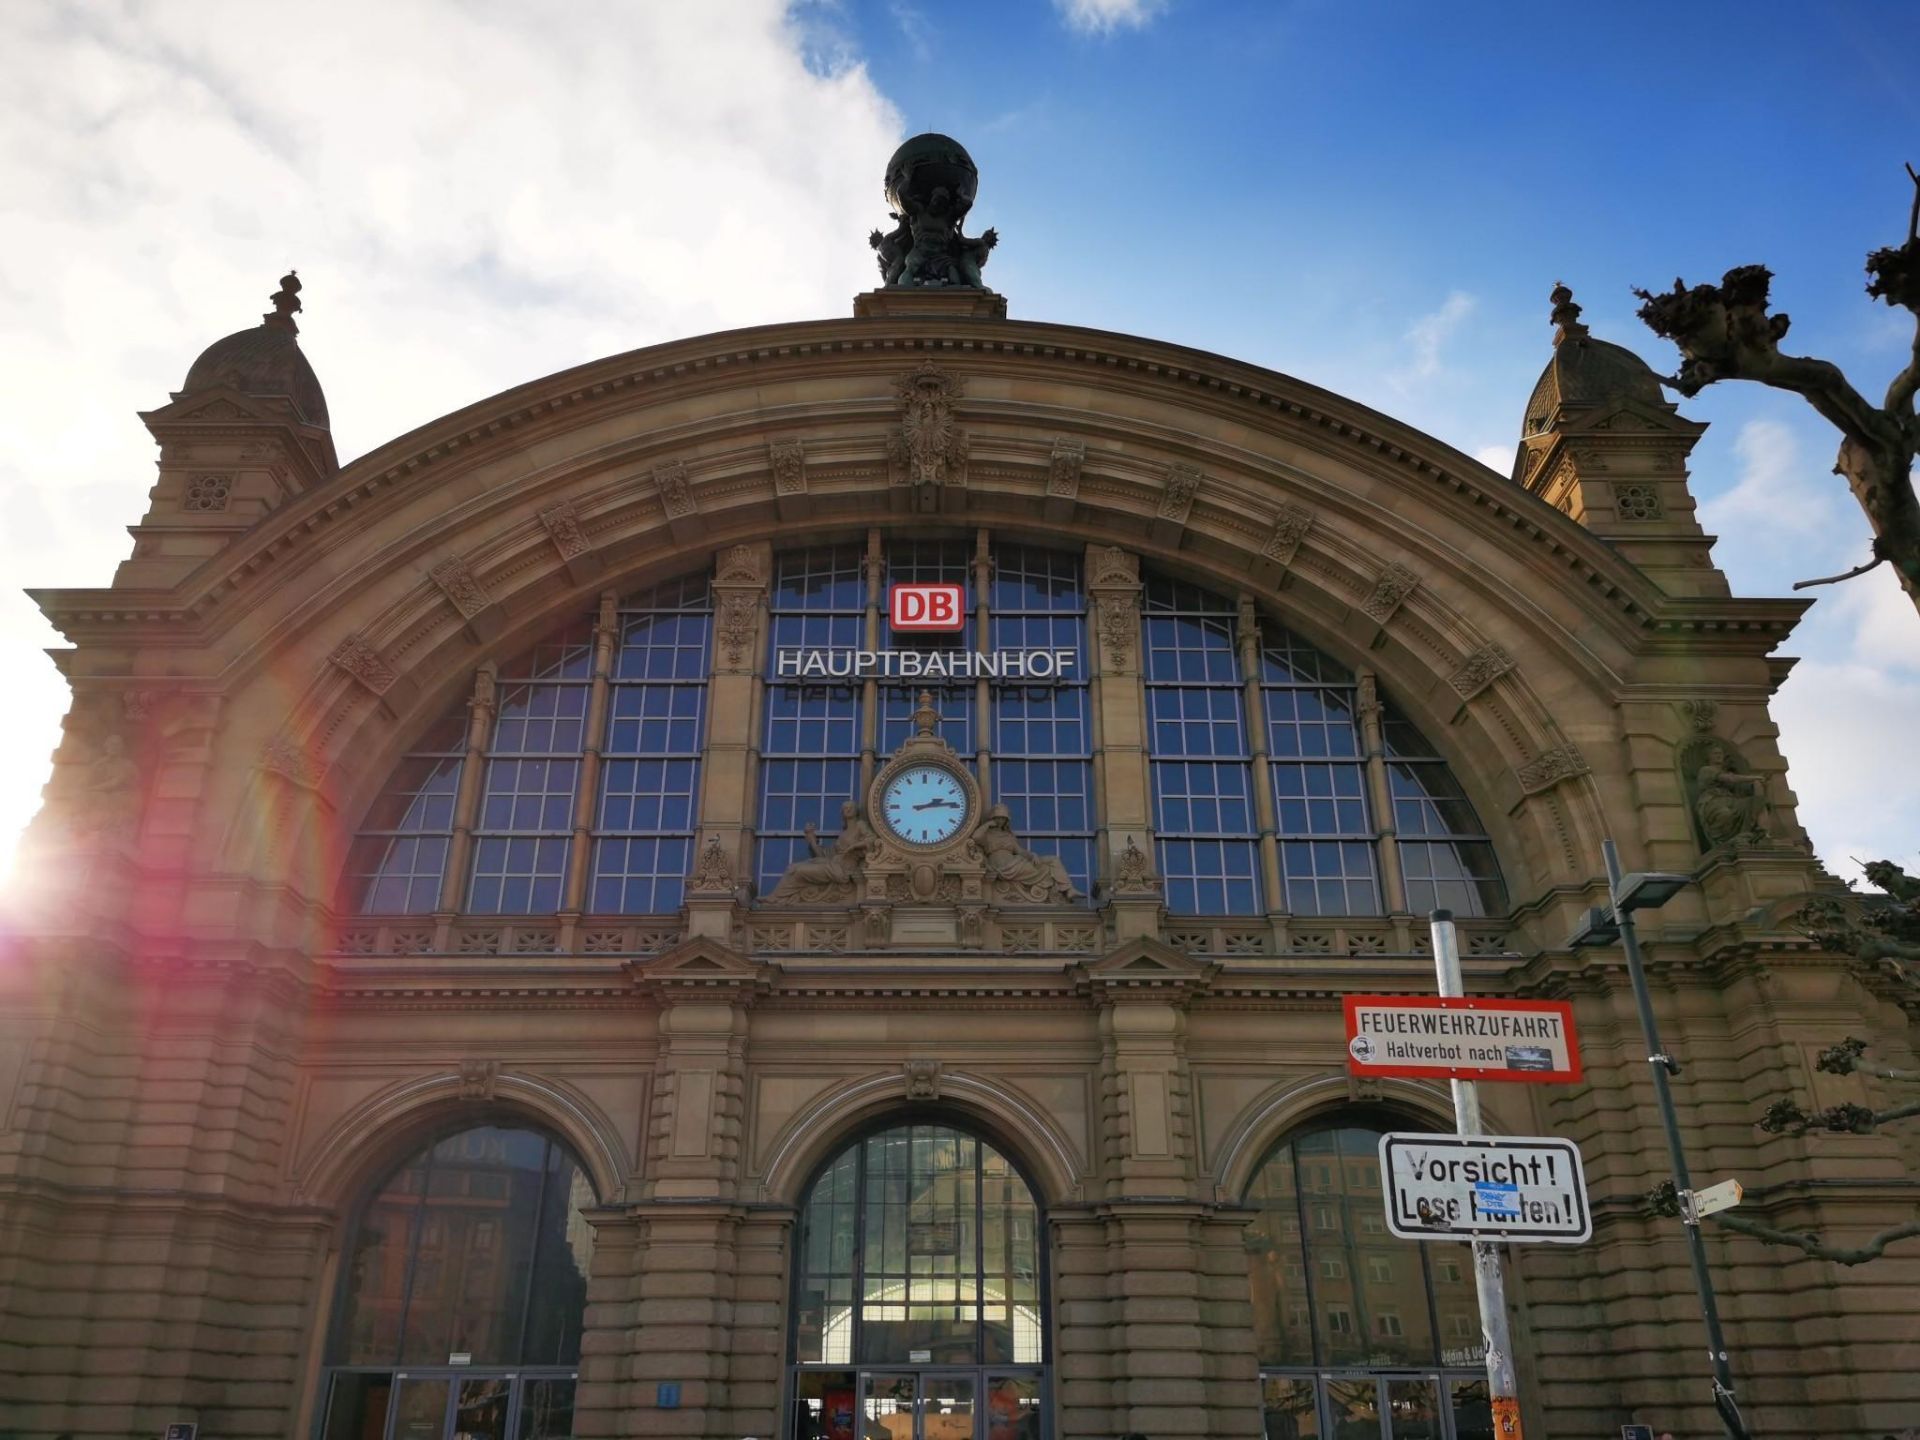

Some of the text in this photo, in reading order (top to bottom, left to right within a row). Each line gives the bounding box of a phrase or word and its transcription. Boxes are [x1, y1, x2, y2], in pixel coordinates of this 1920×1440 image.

[900, 591, 954, 622] DB
[777, 650, 1075, 678] HAUPTBAHNHOF
[1360, 1013, 1559, 1039] FEUERWEHRZUFAHRT
[1387, 1041, 1462, 1060] Haltverbot
[1469, 1045, 1503, 1061] nach
[1405, 1150, 1556, 1185] Vorsicht!
[1400, 1188, 1461, 1221] Lose
